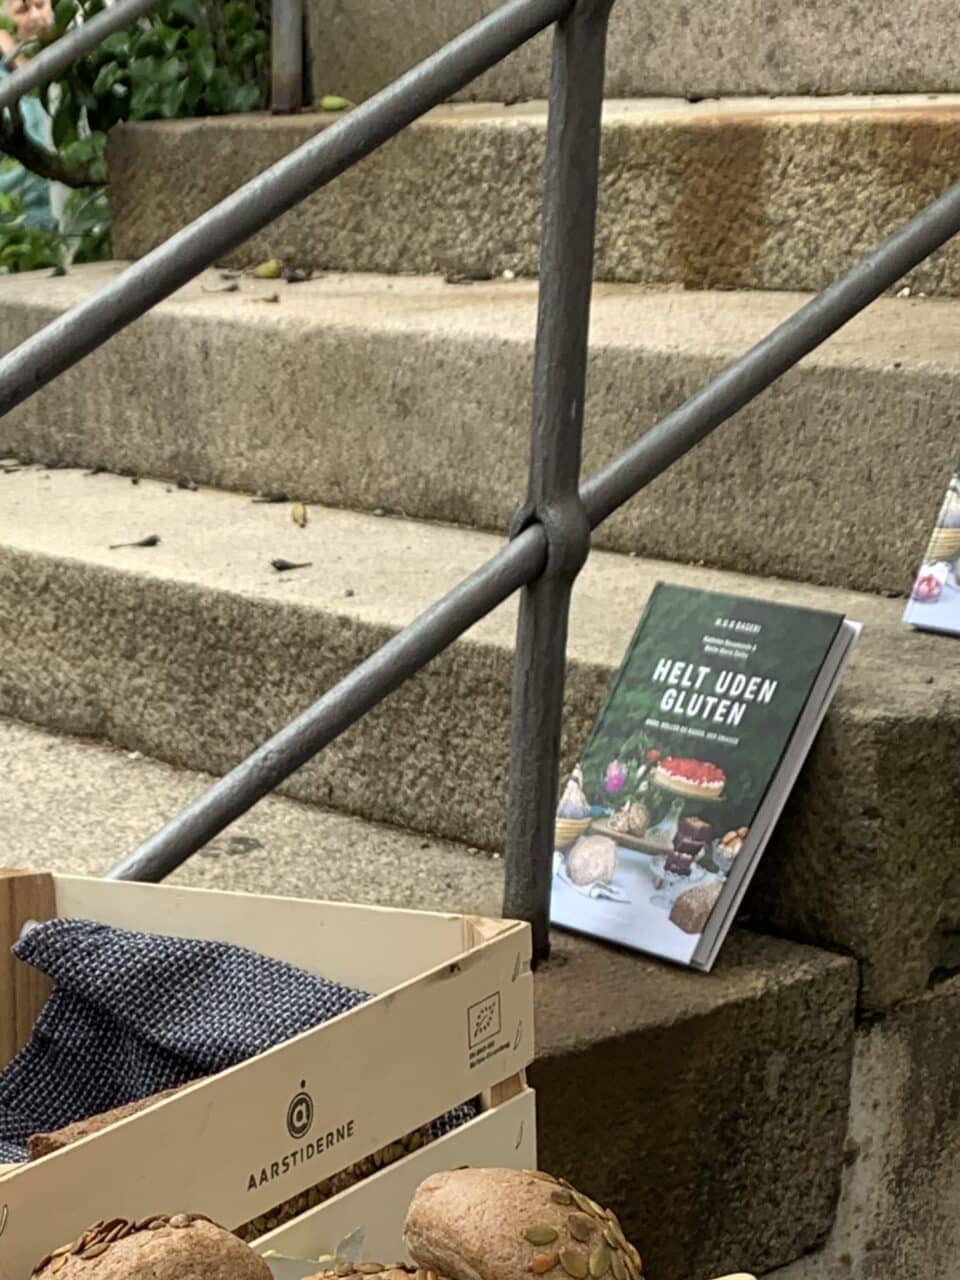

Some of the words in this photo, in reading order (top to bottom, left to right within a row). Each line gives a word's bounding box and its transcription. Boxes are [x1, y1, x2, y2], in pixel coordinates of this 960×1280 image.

[652, 658, 711, 690] HELT
[715, 670, 778, 704] UDEN
[660, 688, 747, 726] GLUTEN
[247, 1120, 355, 1192] AARSTIDERNE
